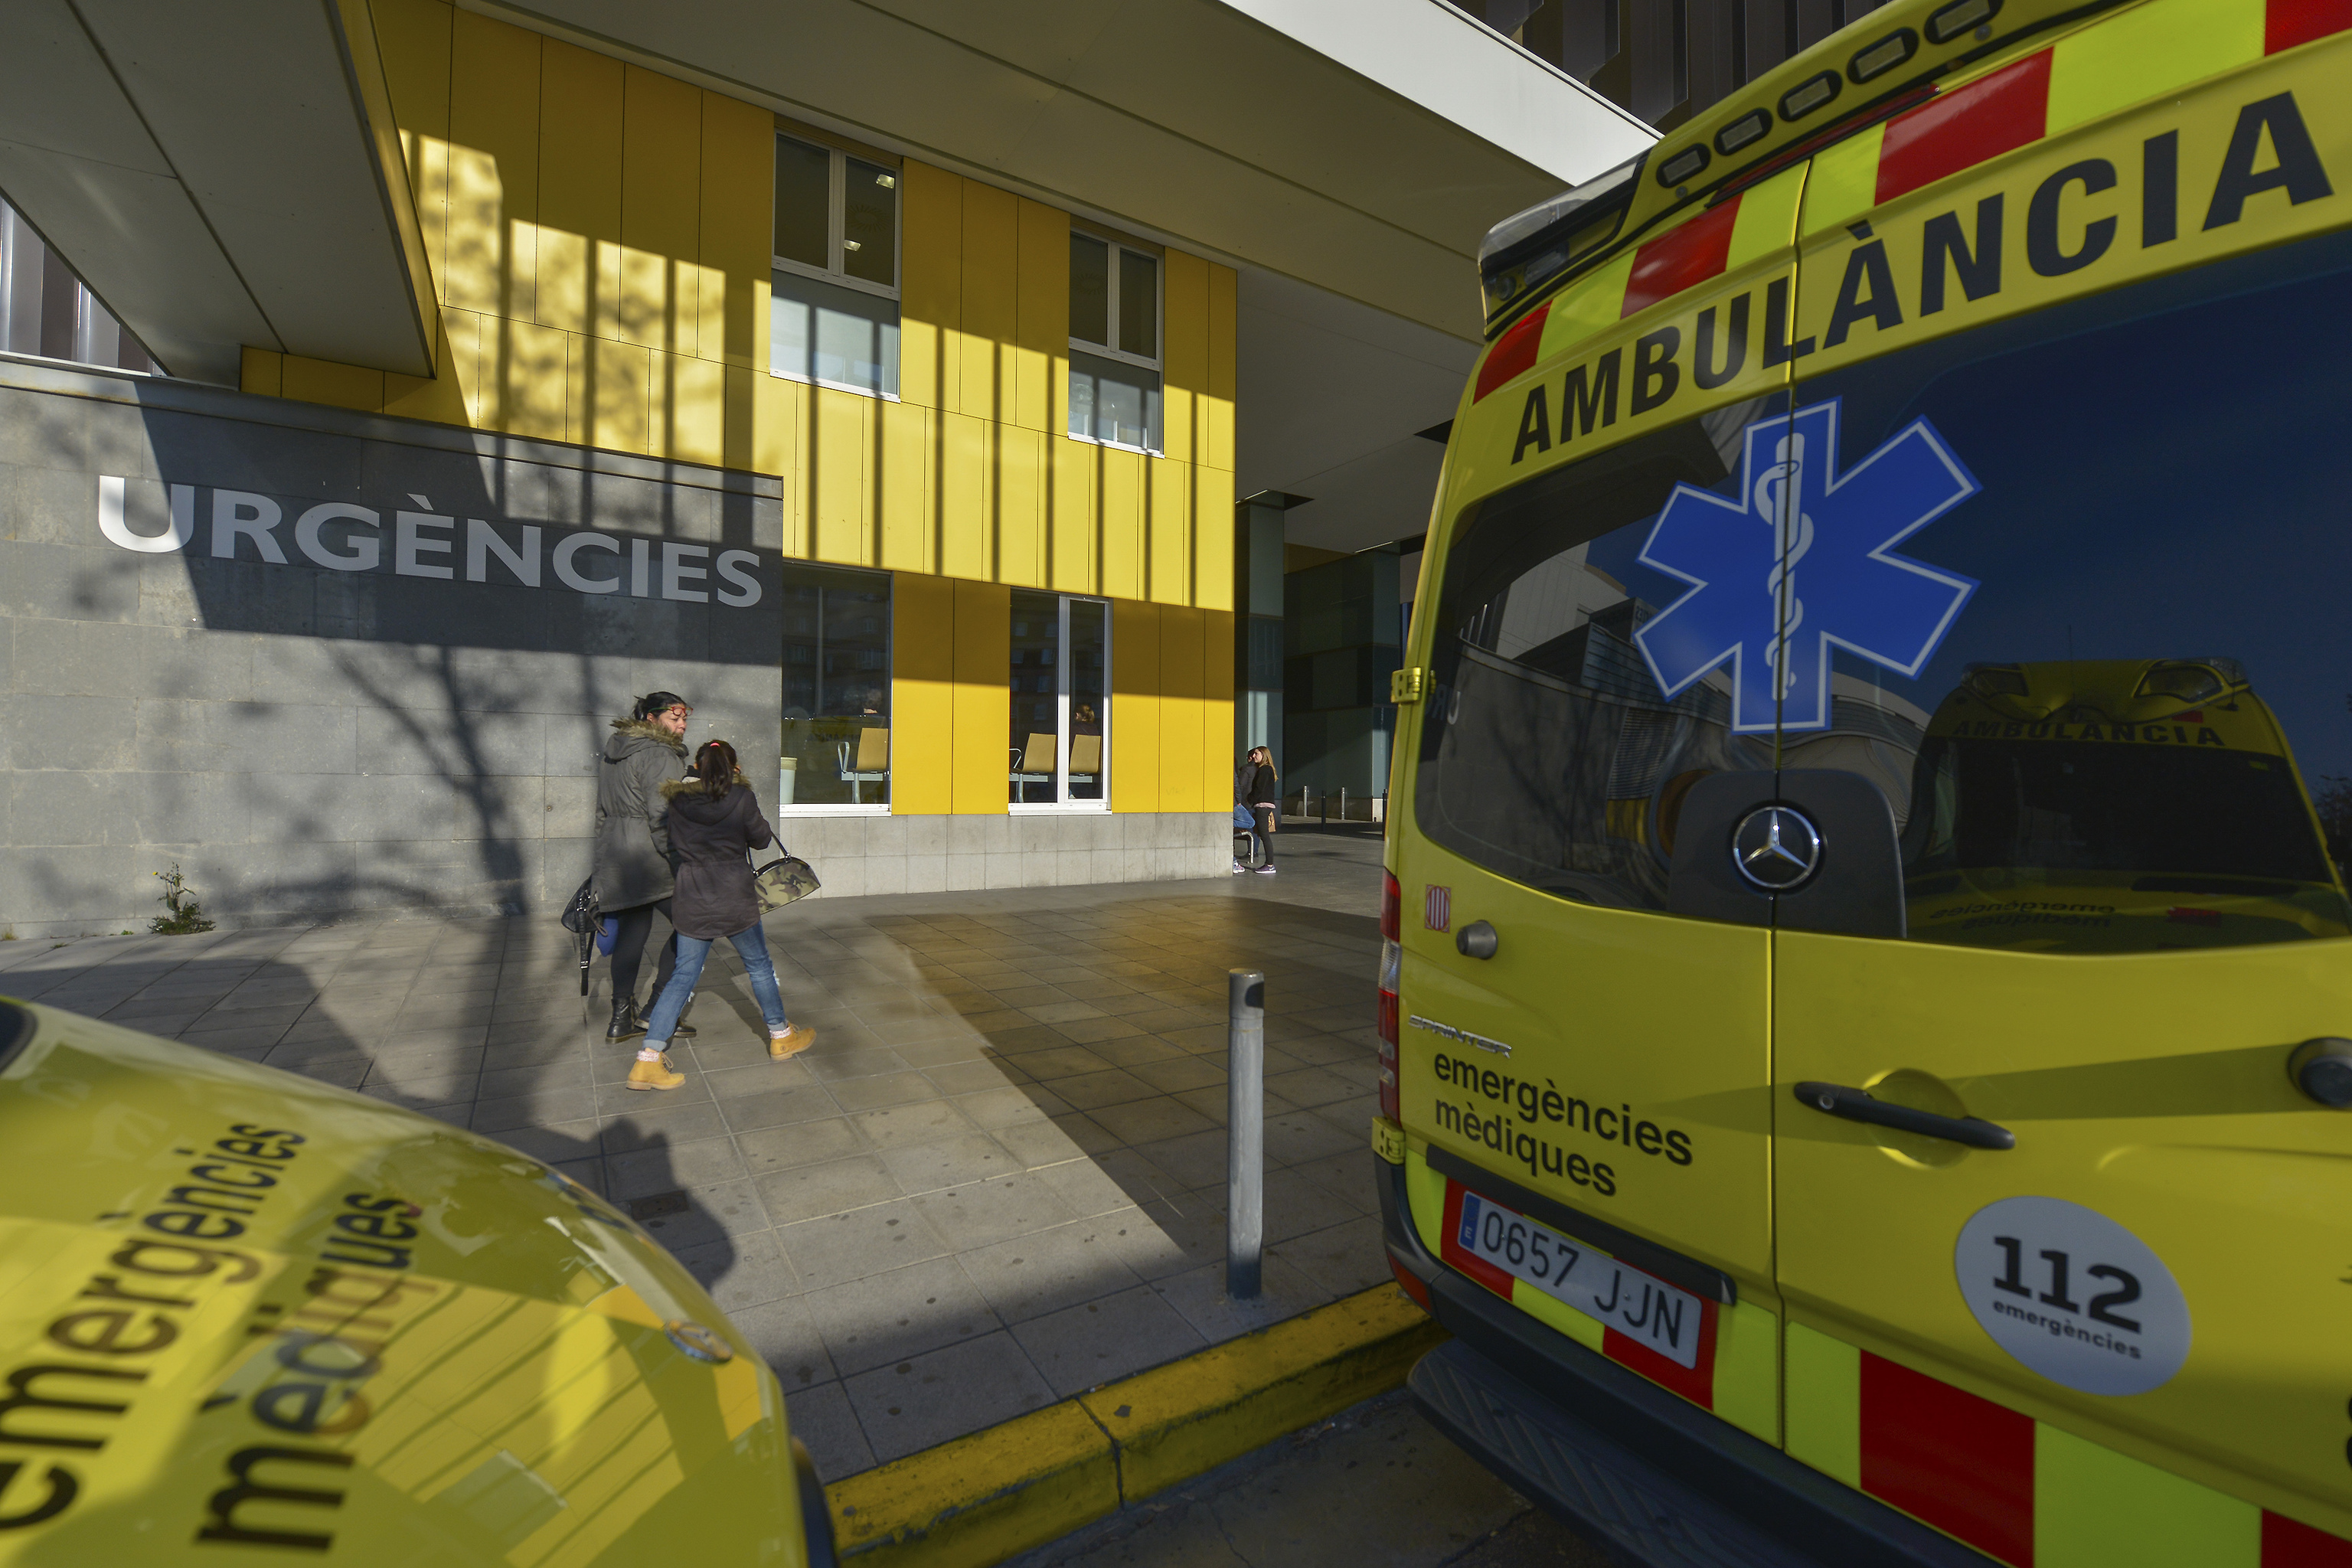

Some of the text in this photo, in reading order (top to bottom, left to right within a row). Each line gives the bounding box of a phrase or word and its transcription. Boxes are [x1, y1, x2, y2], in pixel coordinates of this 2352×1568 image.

[1510, 90, 2334, 466] AMBULÀNCIA
[97, 474, 763, 608] URGÈNCIES
[1434, 1052, 1694, 1166] emergències
[1435, 1099, 1617, 1197] mèdiques
[1482, 1211, 1580, 1288] 0657
[1593, 1269, 1684, 1350] JJN
[1993, 1236, 2142, 1335] 112
[1993, 1300, 2142, 1360] emergències
